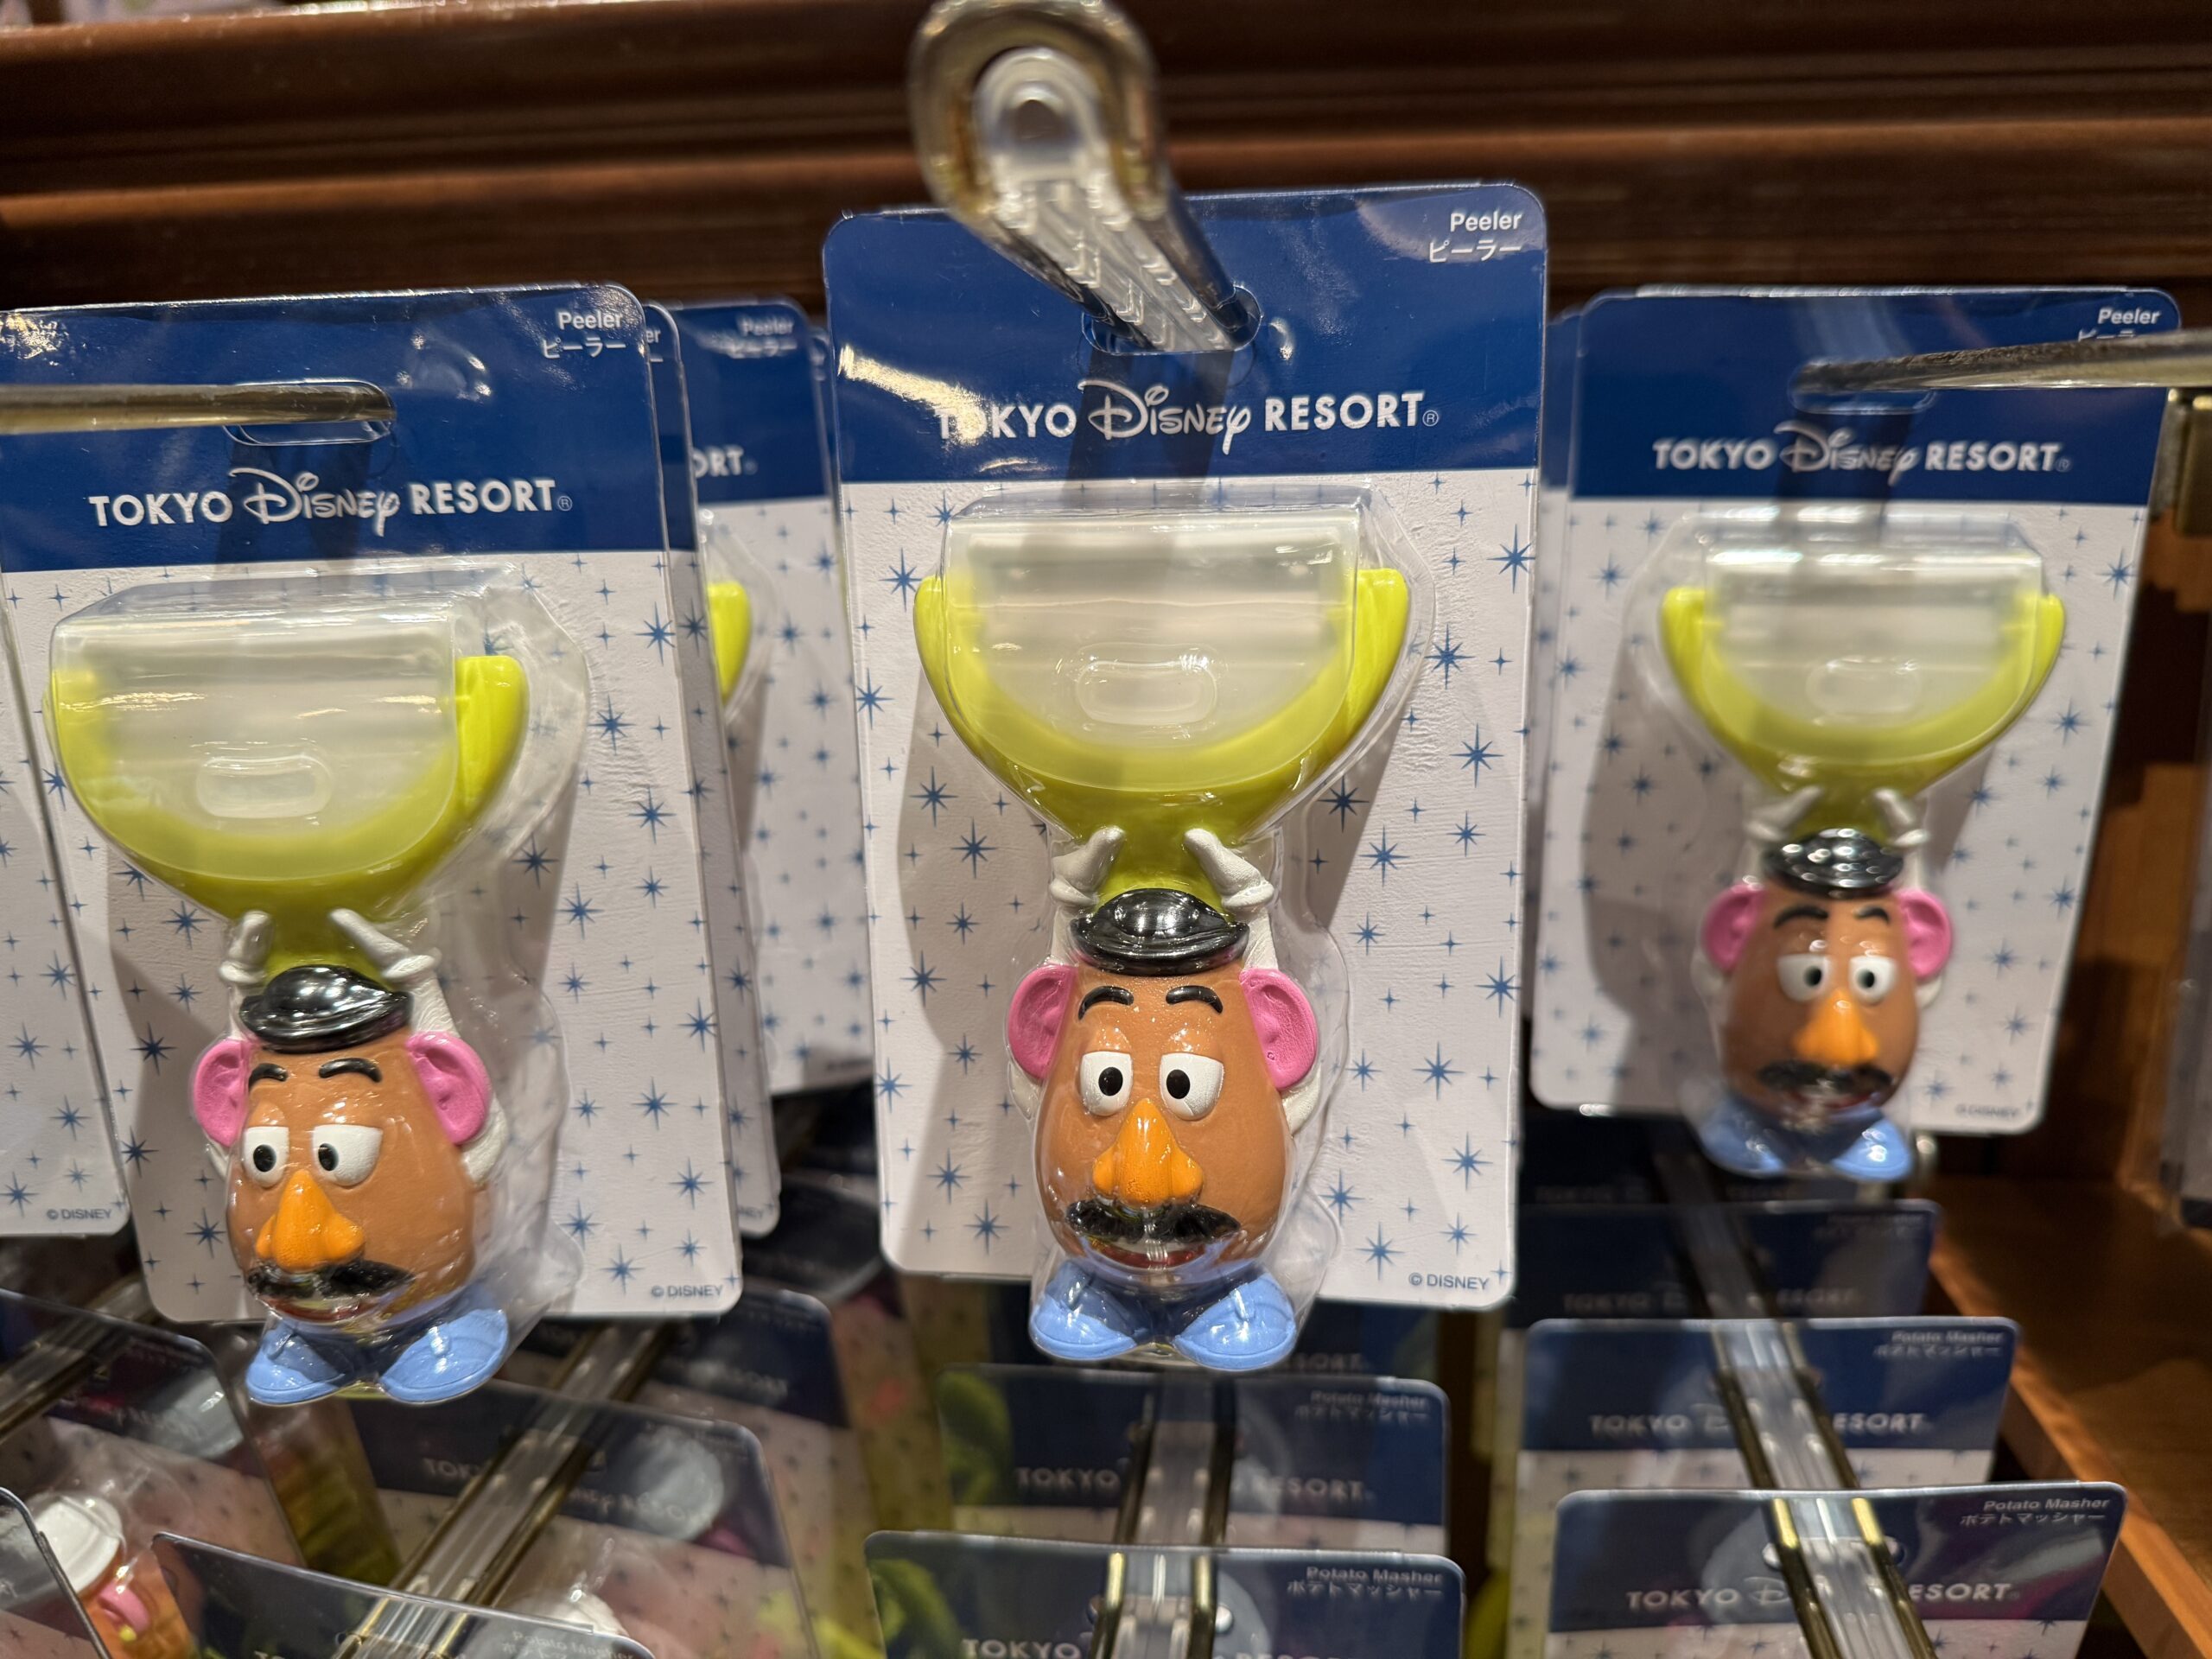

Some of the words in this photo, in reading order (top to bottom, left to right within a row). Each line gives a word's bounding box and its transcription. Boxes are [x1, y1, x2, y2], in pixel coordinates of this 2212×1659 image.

[1450, 210, 1522, 232] Peeler
[1429, 238, 1522, 264] ピーラー
[558, 310, 624, 330] Peeler
[2097, 308, 2161, 325] Peeler
[542, 337, 626, 359] ピーラー
[1652, 435, 1777, 471] TOKYO
[88, 490, 233, 527] TOKYO
[667, 1285, 723, 1298] DISNEY
[1426, 1274, 1490, 1290] DISNEY
[1832, 1413, 1925, 1436] ESORT
[1017, 1468, 1122, 1489] TOKYO
[1984, 1500, 2040, 1510] Potato
[2044, 1498, 2109, 1510] Masher
[1306, 1567, 1368, 1580] Potato
[1373, 1568, 1443, 1583] Masher
[1626, 1589, 1741, 1609] TOKYO
[1909, 1583, 2011, 1602] ESORT
[963, 1639, 1080, 1659] TOKYO
